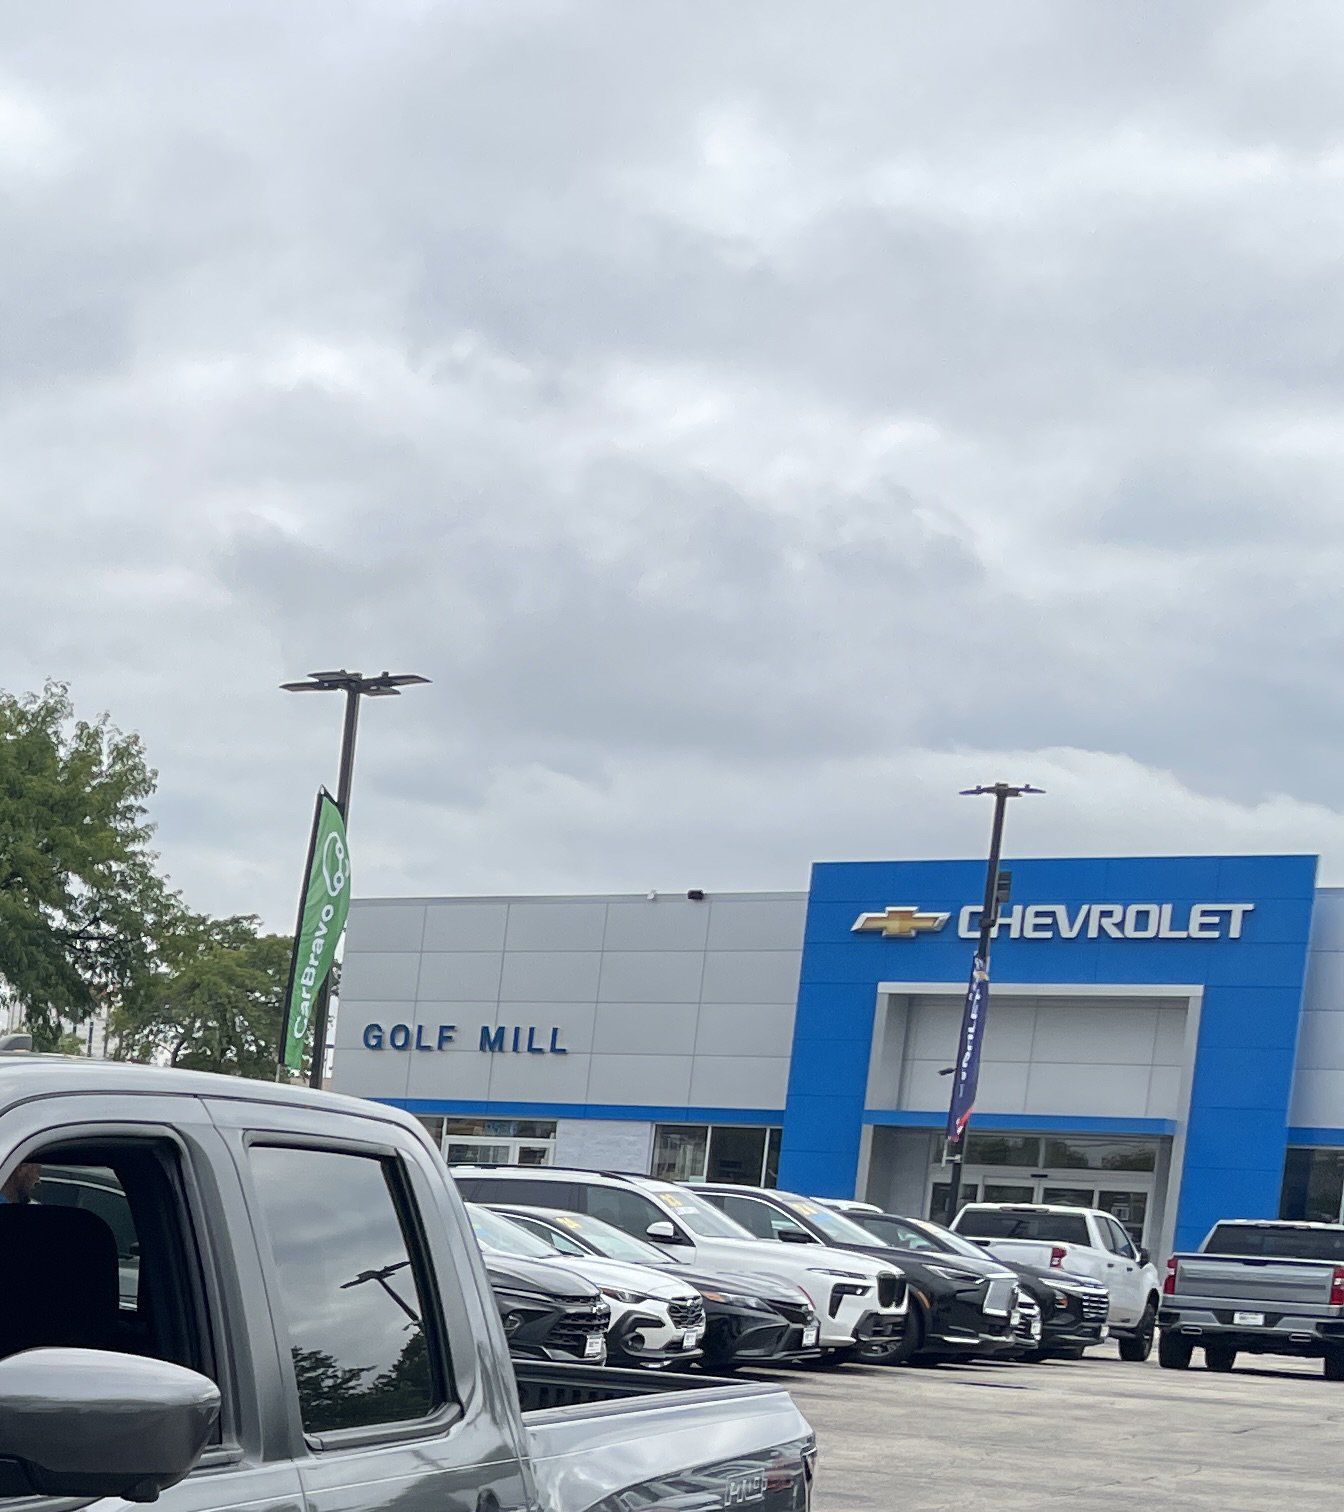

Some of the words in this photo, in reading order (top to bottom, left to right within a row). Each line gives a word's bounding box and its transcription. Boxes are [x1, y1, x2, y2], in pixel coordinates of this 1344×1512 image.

[957, 902, 1255, 940] CHEVROLET
[293, 903, 335, 1039] CarBravo
[363, 1023, 456, 1051] GOLF
[479, 1025, 568, 1054] MILL
